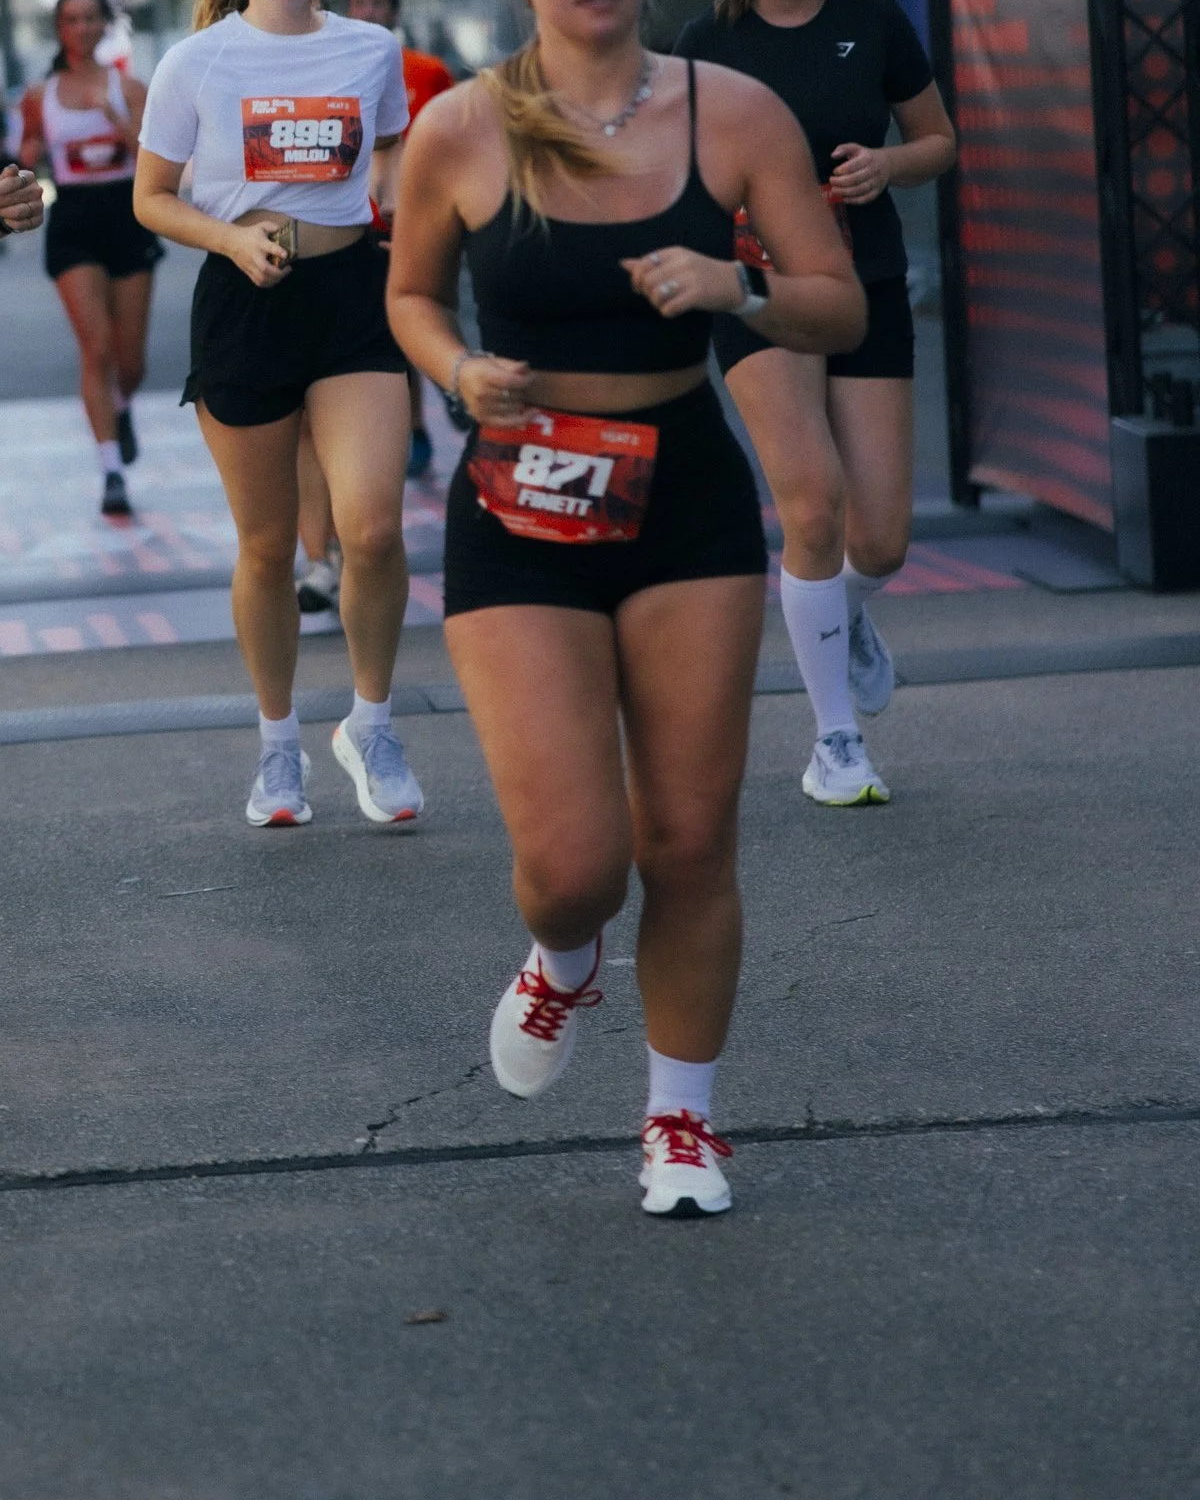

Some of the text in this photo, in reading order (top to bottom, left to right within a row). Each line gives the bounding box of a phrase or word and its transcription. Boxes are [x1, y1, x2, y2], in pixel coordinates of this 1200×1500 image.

[270, 119, 343, 148] 899
[284, 148, 330, 162] MILOU
[513, 444, 615, 498] 871
